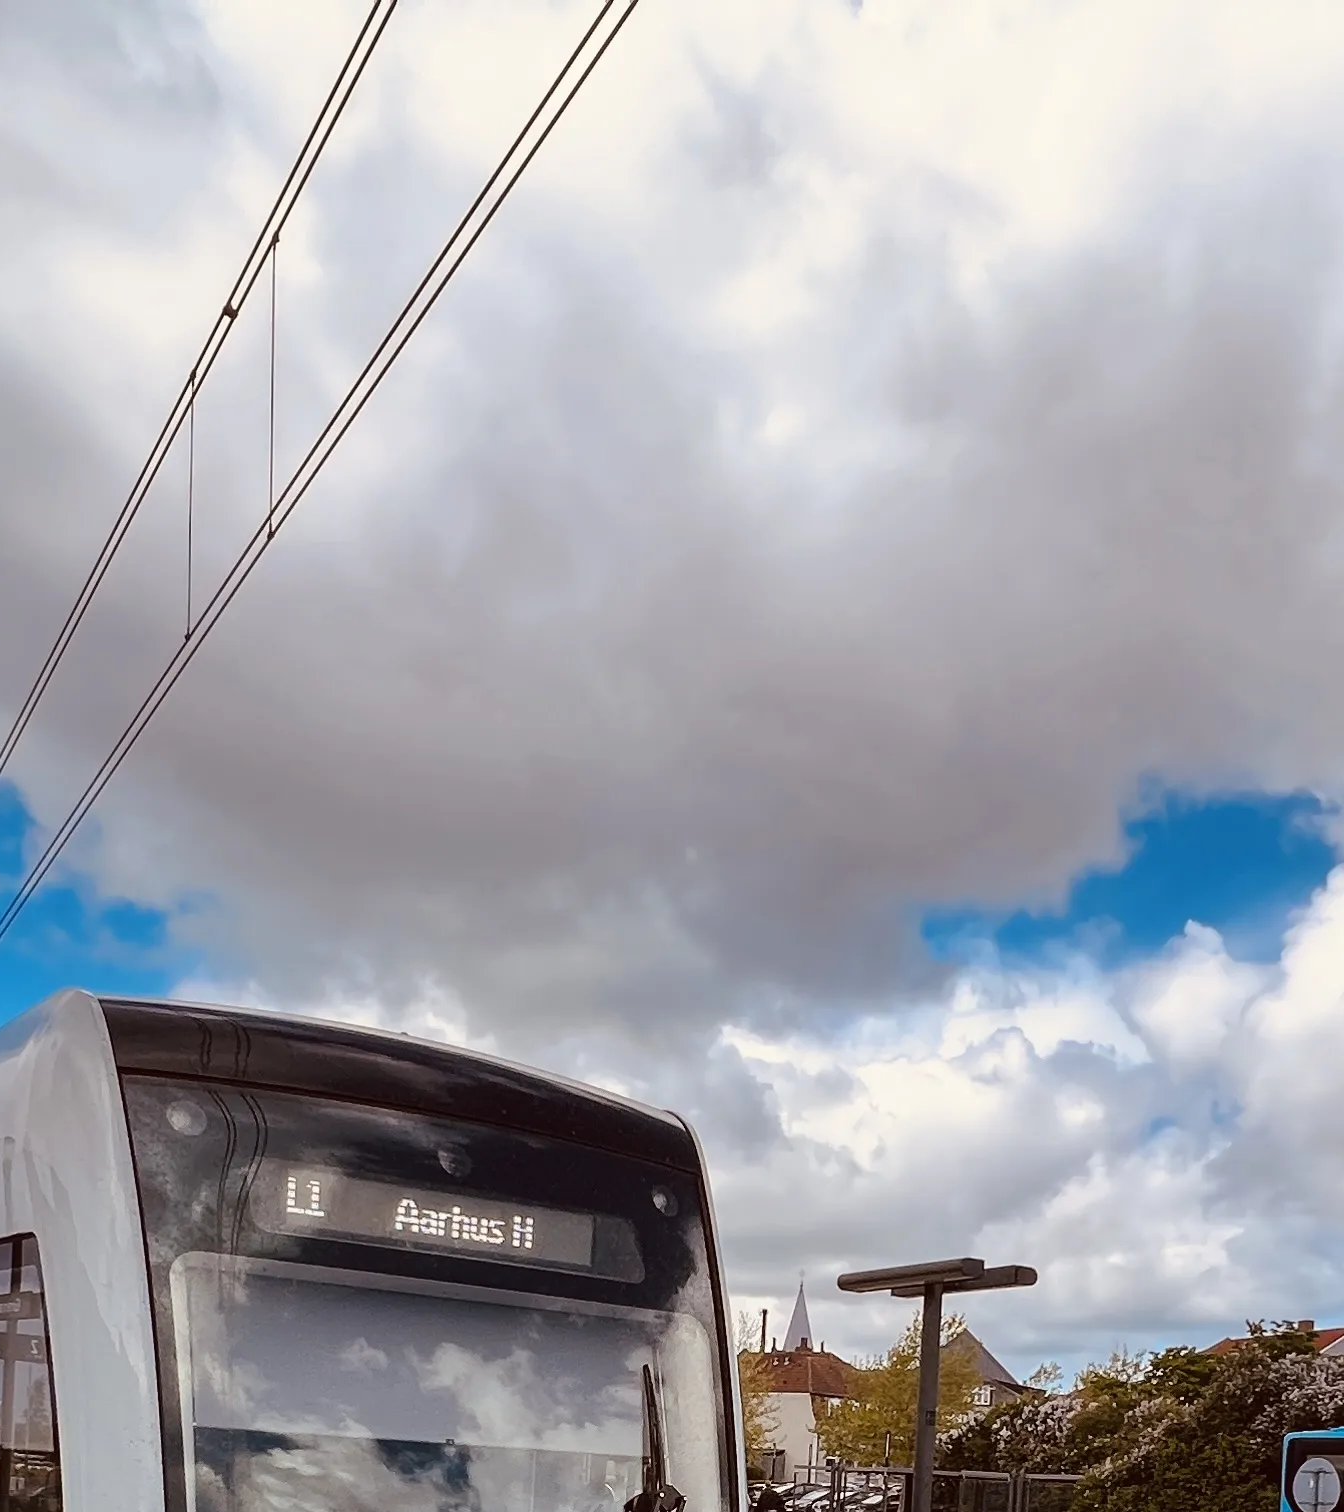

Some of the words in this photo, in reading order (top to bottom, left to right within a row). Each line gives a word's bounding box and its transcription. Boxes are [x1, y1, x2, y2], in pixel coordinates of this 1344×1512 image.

[285, 1176, 325, 1218] L1
[394, 1197, 507, 1246] Aarhus
[512, 1214, 535, 1250] H
